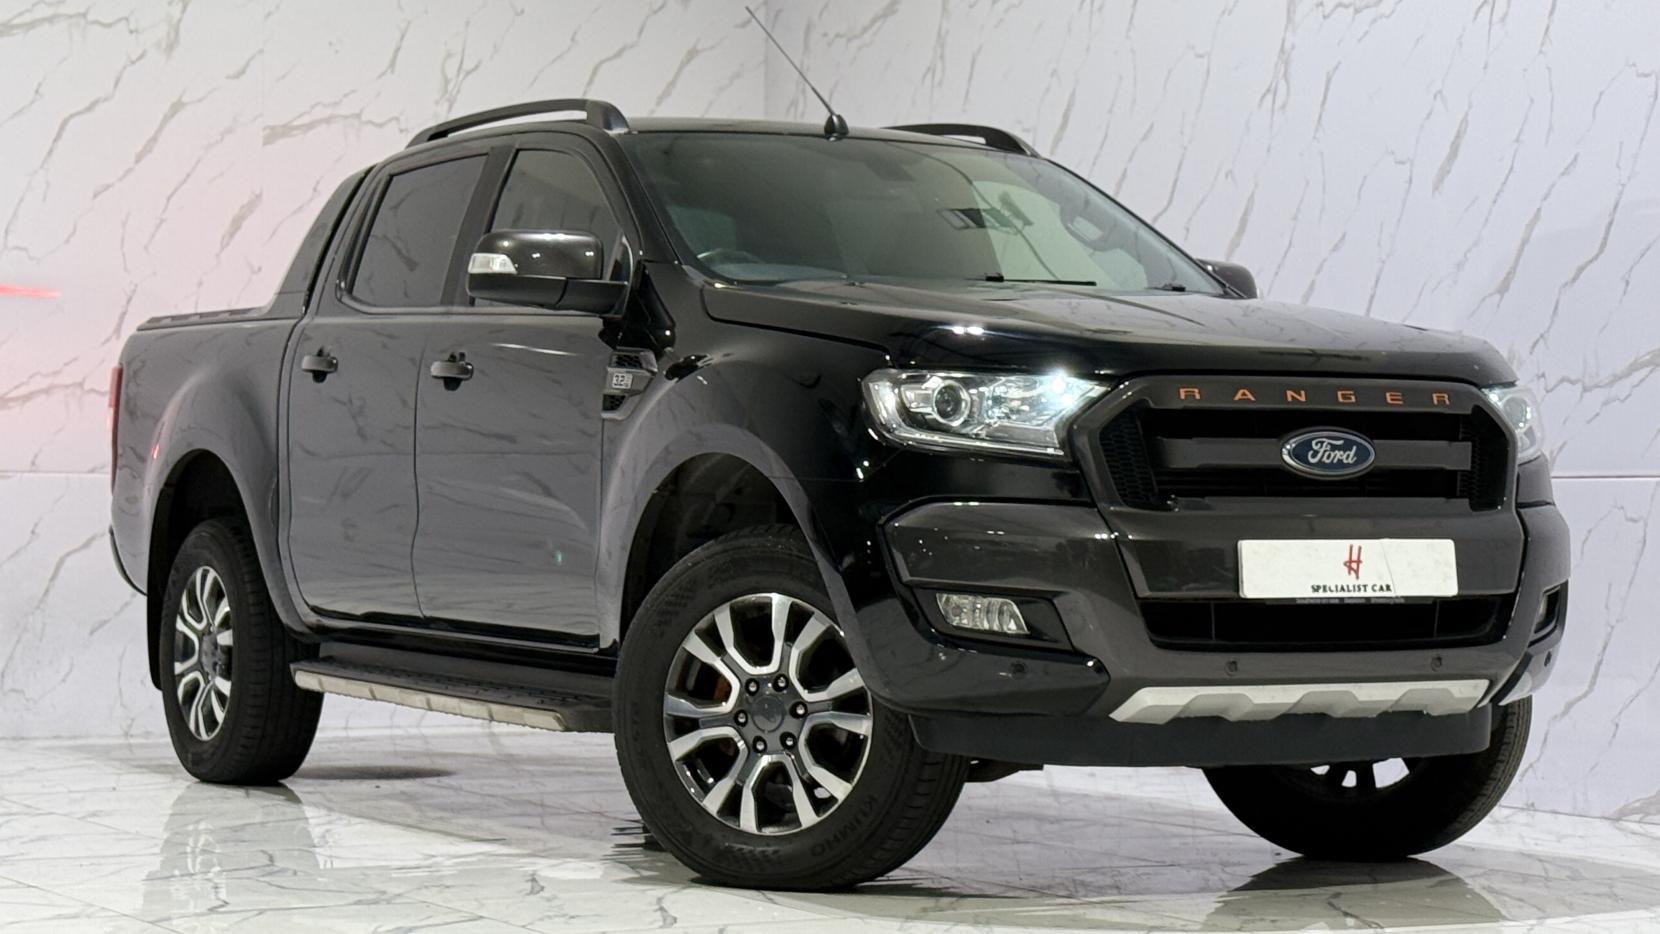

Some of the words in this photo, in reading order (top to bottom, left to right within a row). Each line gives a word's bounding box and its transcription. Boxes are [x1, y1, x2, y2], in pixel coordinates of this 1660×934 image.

[1179, 387, 1450, 406] RANGER
[1307, 437, 1357, 465] Ford
[1310, 584, 1368, 594] SPECIALIST
[1371, 583, 1392, 593] CAR
